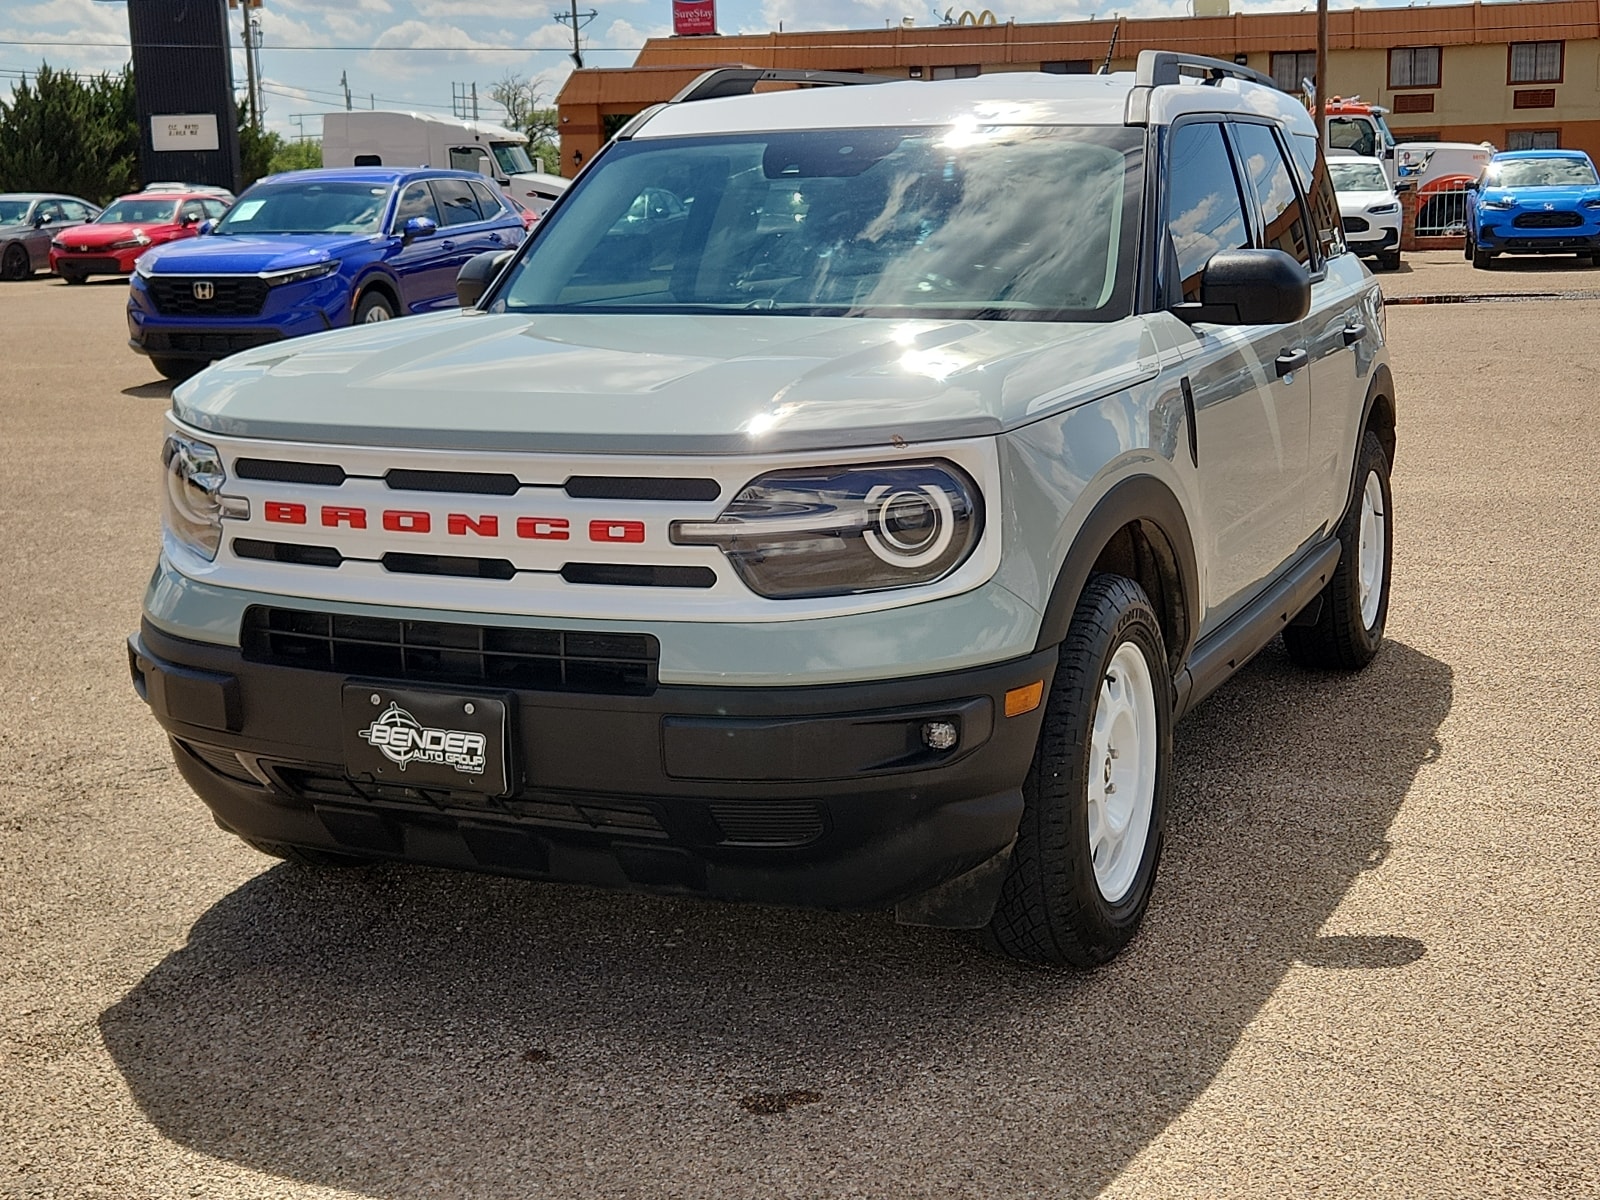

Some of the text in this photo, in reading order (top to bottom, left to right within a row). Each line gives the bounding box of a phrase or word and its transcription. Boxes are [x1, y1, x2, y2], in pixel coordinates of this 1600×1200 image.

[674, 9, 713, 20] SureStay
[264, 501, 646, 543] BRONCO
[370, 724, 484, 755] BENDER
[413, 749, 483, 766] AUTO GROUP
